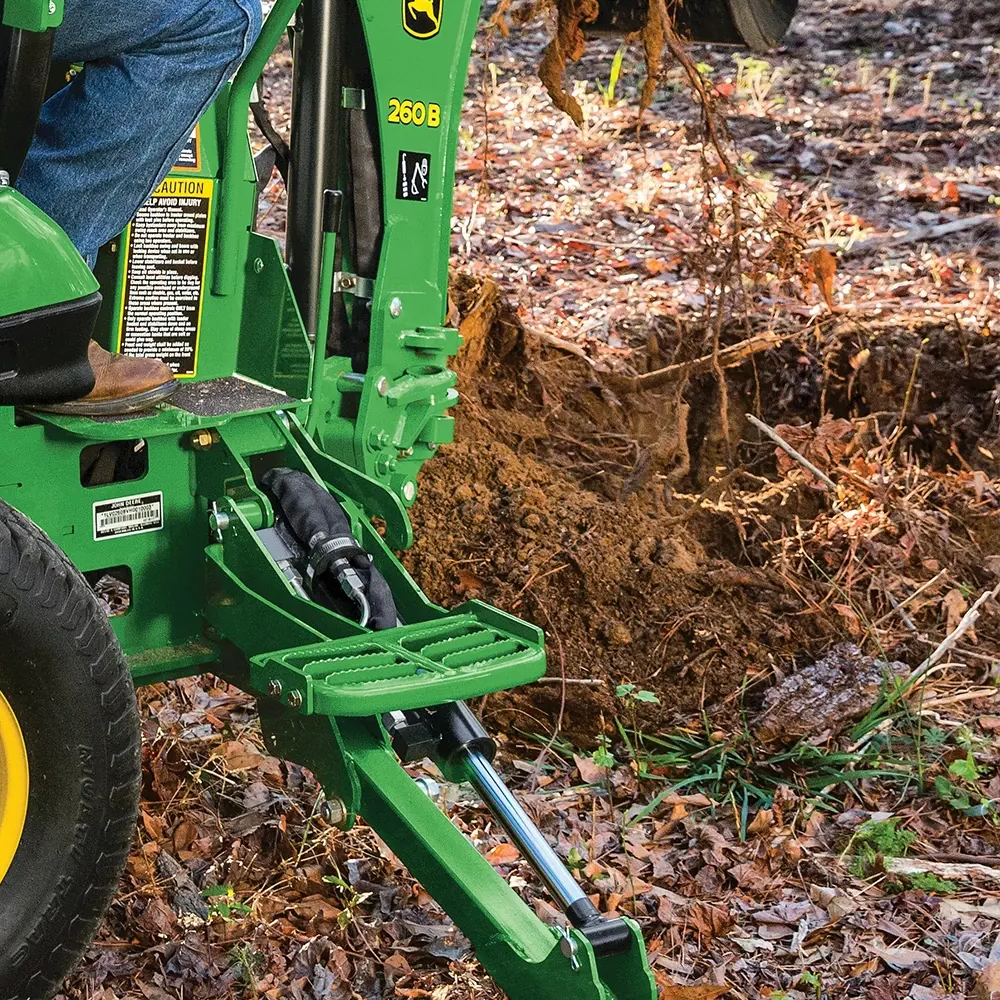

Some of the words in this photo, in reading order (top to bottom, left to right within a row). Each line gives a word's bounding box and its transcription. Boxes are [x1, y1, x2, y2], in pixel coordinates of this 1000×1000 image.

[144, 198, 158, 206] ELP
[159, 198, 178, 207] AVOID
[179, 198, 202, 207] INJURY
[111, 501, 125, 509] JOHN
[125, 498, 141, 506] DEERE
